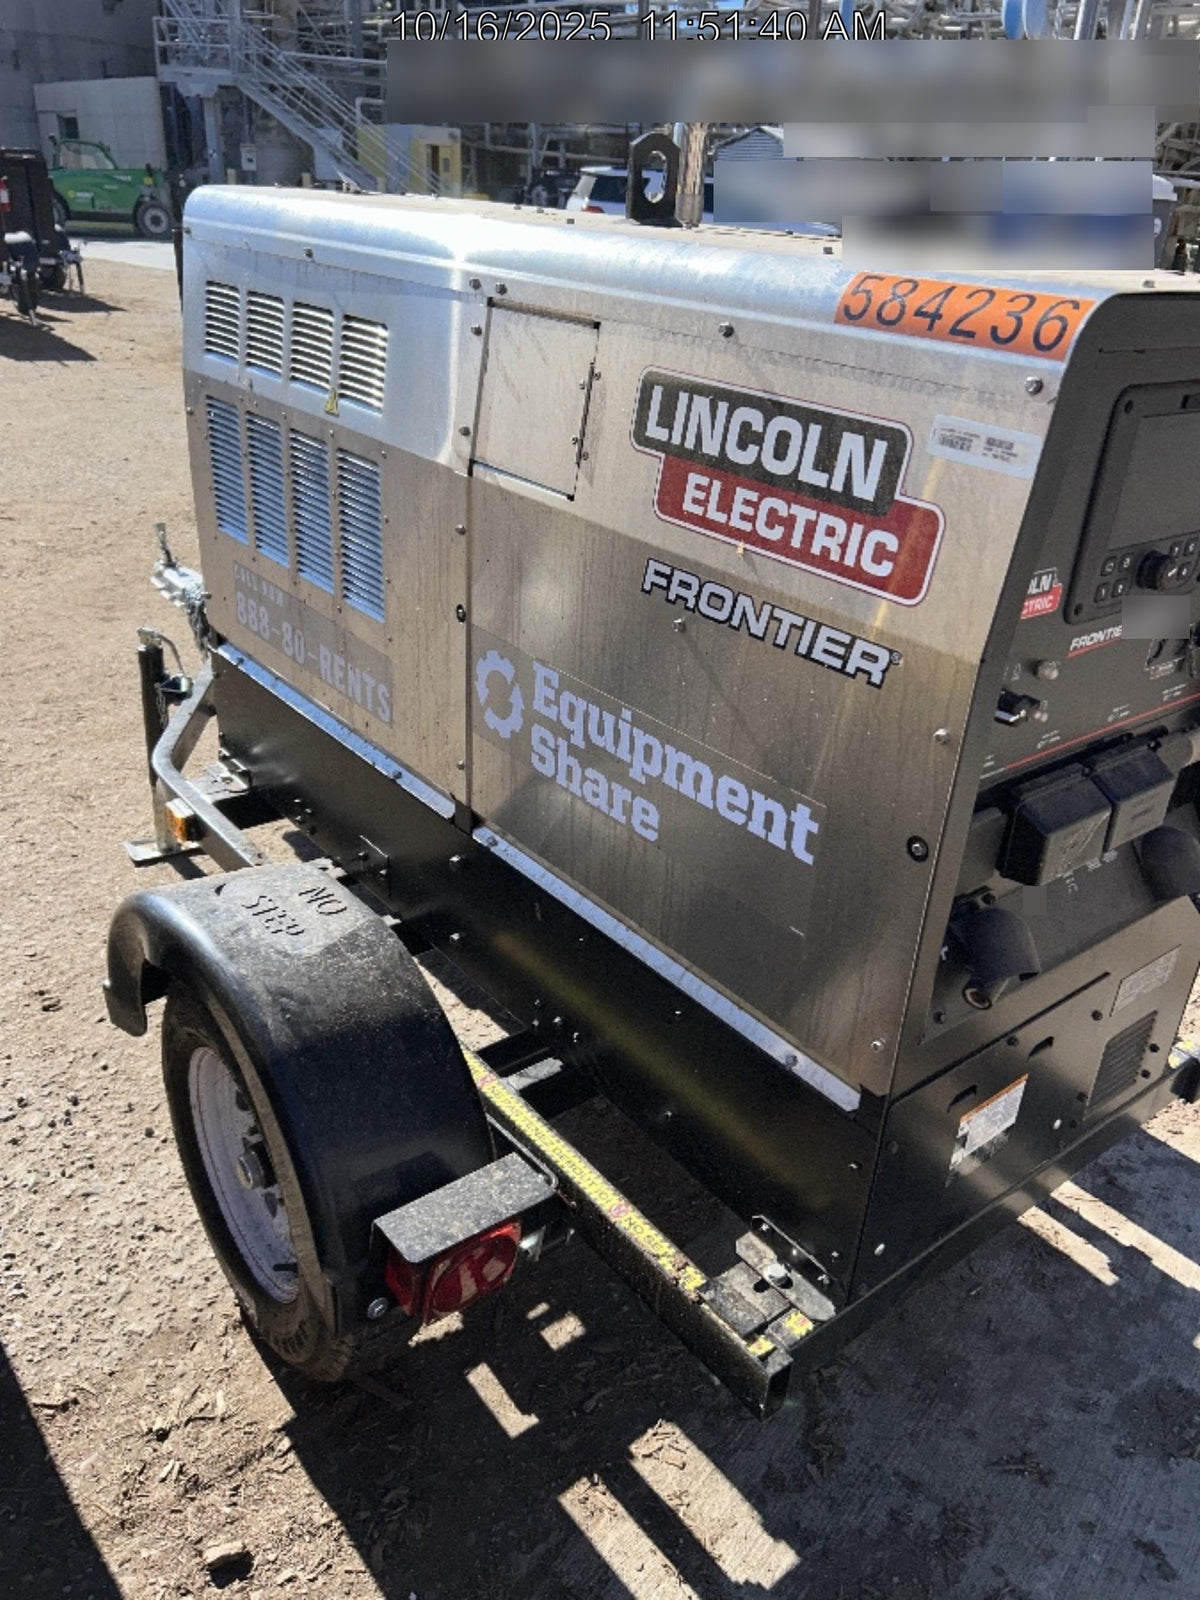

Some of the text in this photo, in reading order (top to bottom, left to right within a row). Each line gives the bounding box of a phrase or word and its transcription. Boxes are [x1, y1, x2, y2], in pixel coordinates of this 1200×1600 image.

[843, 274, 1080, 351] 584236
[645, 385, 888, 501] LINCOLN
[682, 472, 899, 577] ELECTRIC
[236, 591, 391, 724] 888-80-RENTS
[1070, 624, 1122, 651] FRONTIE
[530, 723, 660, 842] Share
[533, 660, 819, 866] Equipment
[241, 895, 305, 937] STEP
[298, 886, 348, 916] NO
[552, 1146, 597, 1187] DEBOUT
